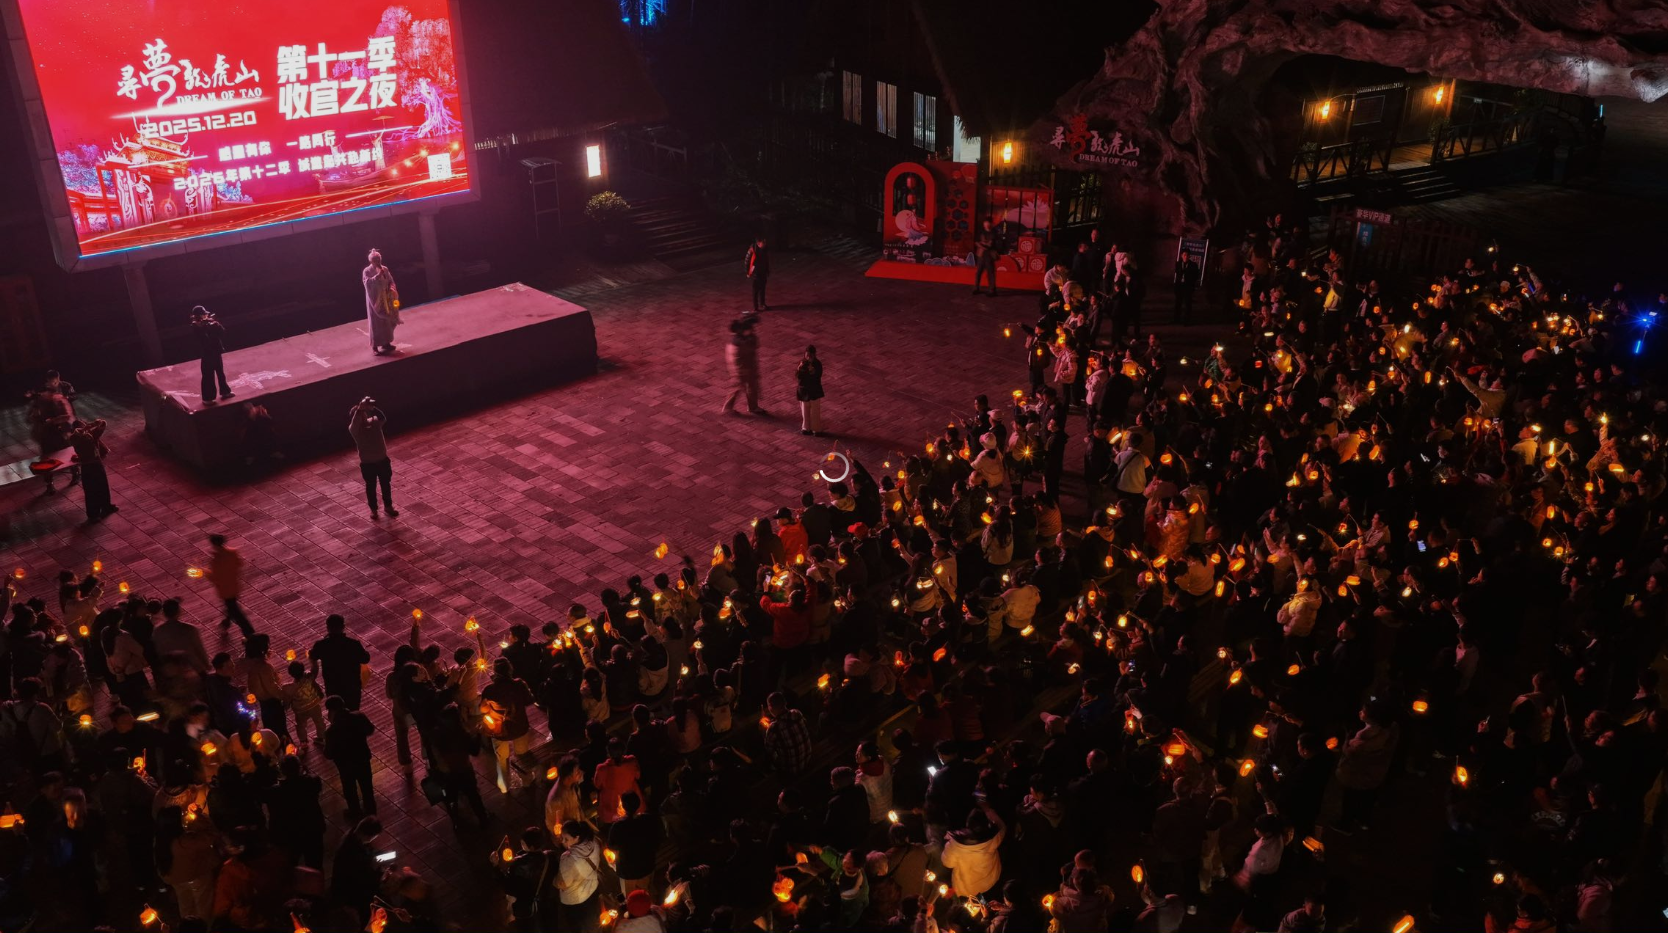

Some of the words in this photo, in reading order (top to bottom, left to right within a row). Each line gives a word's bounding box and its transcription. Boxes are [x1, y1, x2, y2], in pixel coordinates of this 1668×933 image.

[277, 36, 397, 84] 第十一季
[176, 91, 217, 104] DREAM
[221, 89, 235, 100] OF
[239, 87, 262, 99] TAO
[278, 73, 398, 120] 收官之夜
[144, 110, 257, 139] 2025.12.20
[1080, 153, 1108, 163] DREAM
[1109, 156, 1119, 165] OF
[1120, 157, 1138, 168] TAO
